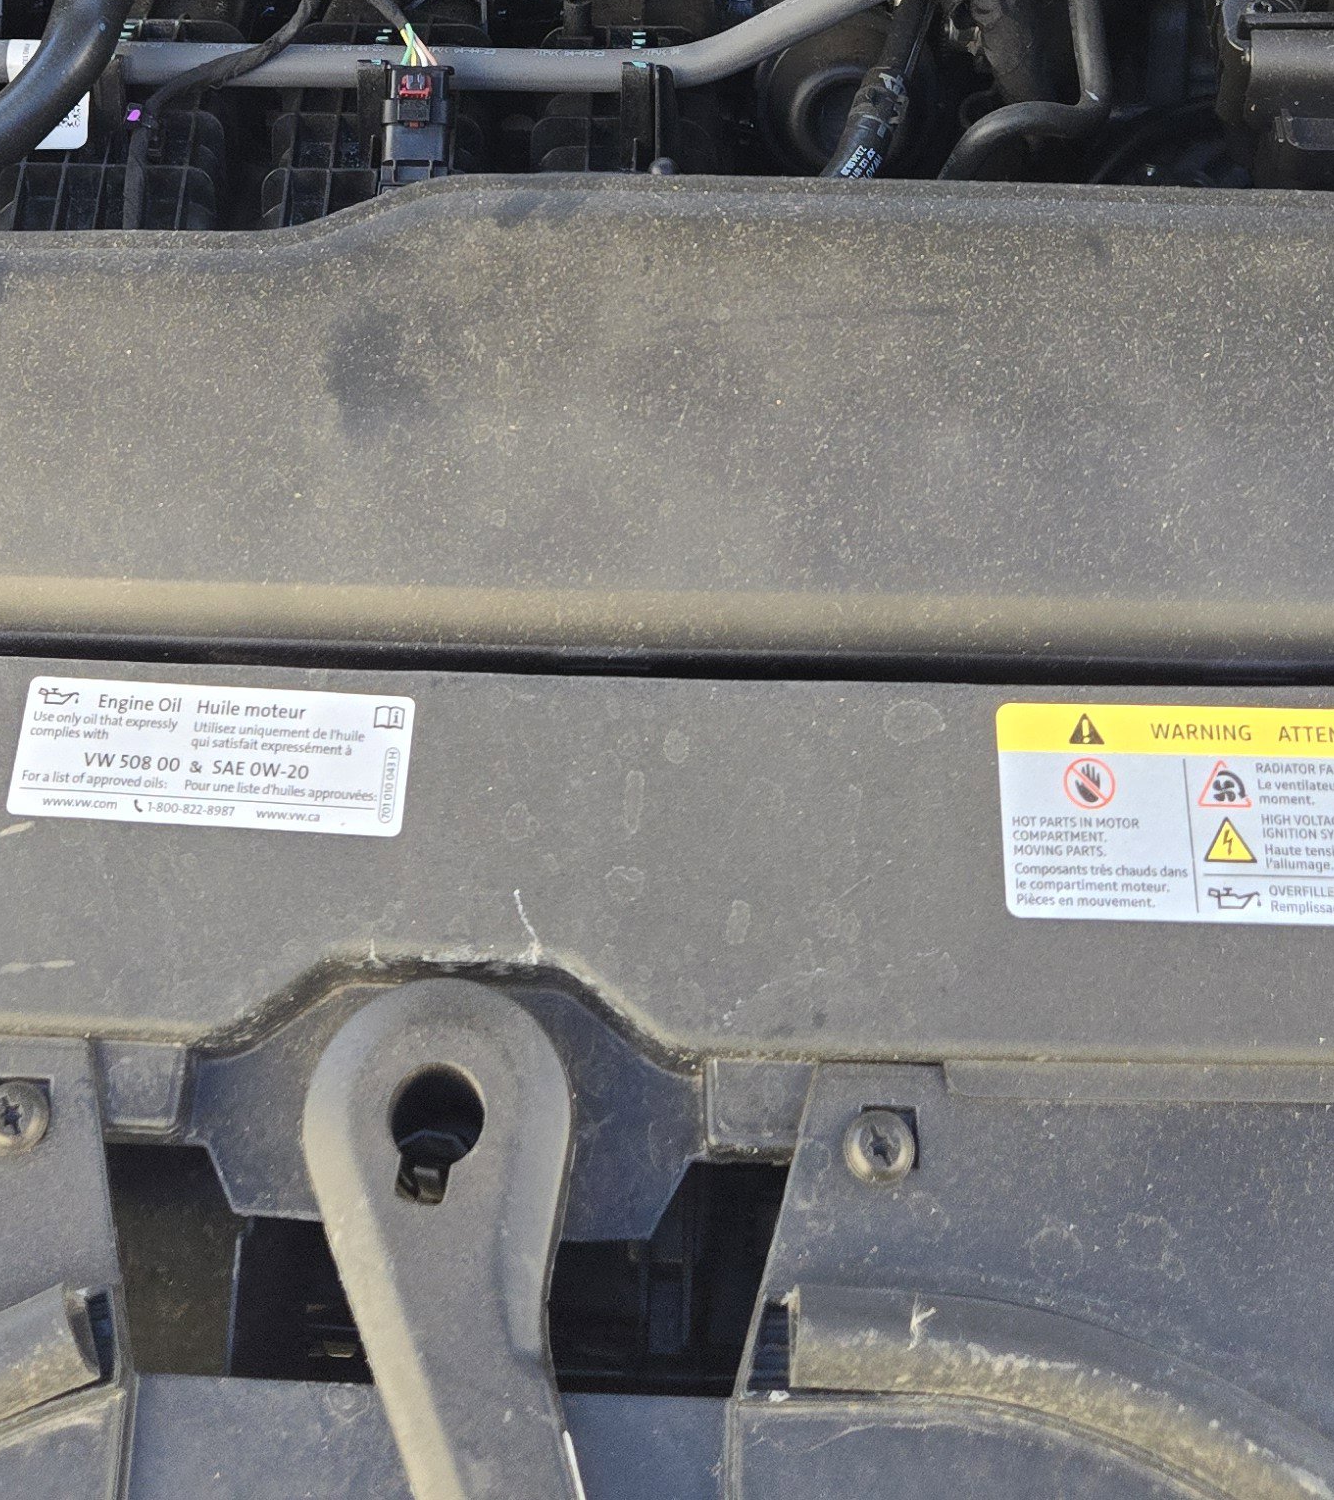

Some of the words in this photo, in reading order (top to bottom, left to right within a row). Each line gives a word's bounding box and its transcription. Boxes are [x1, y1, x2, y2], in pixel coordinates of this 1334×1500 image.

[98, 694, 154, 714] Engine
[159, 697, 182, 713] Oil
[196, 700, 240, 716] Huile
[245, 706, 306, 719] moteur
[33, 711, 55, 721] Use
[57, 711, 82, 726] only
[84, 714, 98, 725] oil
[100, 715, 123, 727] that
[126, 716, 178, 732] expressly
[30, 727, 80, 740] complies
[83, 728, 109, 740] with
[193, 721, 236, 734] Utilisez
[239, 725, 311, 741] uniquement
[313, 730, 326, 740] de
[330, 730, 365, 742] l'huile
[1151, 723, 1252, 741] WARNING
[190, 740, 210, 750] qui
[212, 739, 258, 750] satisfait
[261, 742, 342, 757] expressément
[345, 746, 352, 756] à
[84, 752, 116, 767] VW
[120, 755, 152, 770] 508
[157, 757, 180, 772] 00
[189, 760, 202, 774] &
[212, 760, 245, 776] SAE
[250, 762, 309, 779] 0W-20
[1256, 762, 1315, 775] RADIATOR
[22, 769, 40, 781] For
[42, 772, 49, 782] a
[52, 771, 69, 783] list
[72, 772, 84, 784] of
[86, 773, 141, 788] approved
[144, 776, 167, 789] oils:
[185, 779, 210, 792] Pour
[213, 783, 235, 793] une
[237, 782, 259, 794] liste
[262, 784, 306, 797] d'huiles
[42, 797, 117, 809] www.vw.com
[147, 801, 235, 817] 1-800-822-8987
[256, 809, 320, 823] www.vw.ca
[1012, 816, 1037, 827] HOT
[1040, 816, 1077, 828] PARTS
[1080, 818, 1092, 828] IN
[1096, 818, 1140, 829] MOTOR
[1261, 814, 1291, 825] HIGH
[1013, 830, 1107, 842] COMPARTMENT.
[1263, 828, 1316, 840] IGNITION
[1014, 845, 1063, 856] MOVING
[1066, 846, 1107, 856] PARTS.
[1015, 863, 1088, 876] Composants
[1090, 864, 1112, 875] très
[1115, 865, 1157, 877] chauds
[1162, 866, 1188, 877] dans
[1016, 879, 1026, 889] le
[1030, 879, 1118, 892] compartiment
[1121, 881, 1170, 892] moteur.
[1017, 893, 1055, 905] Pièces
[1058, 897, 1073, 906] en
[1077, 897, 1155, 908] mouvement.
